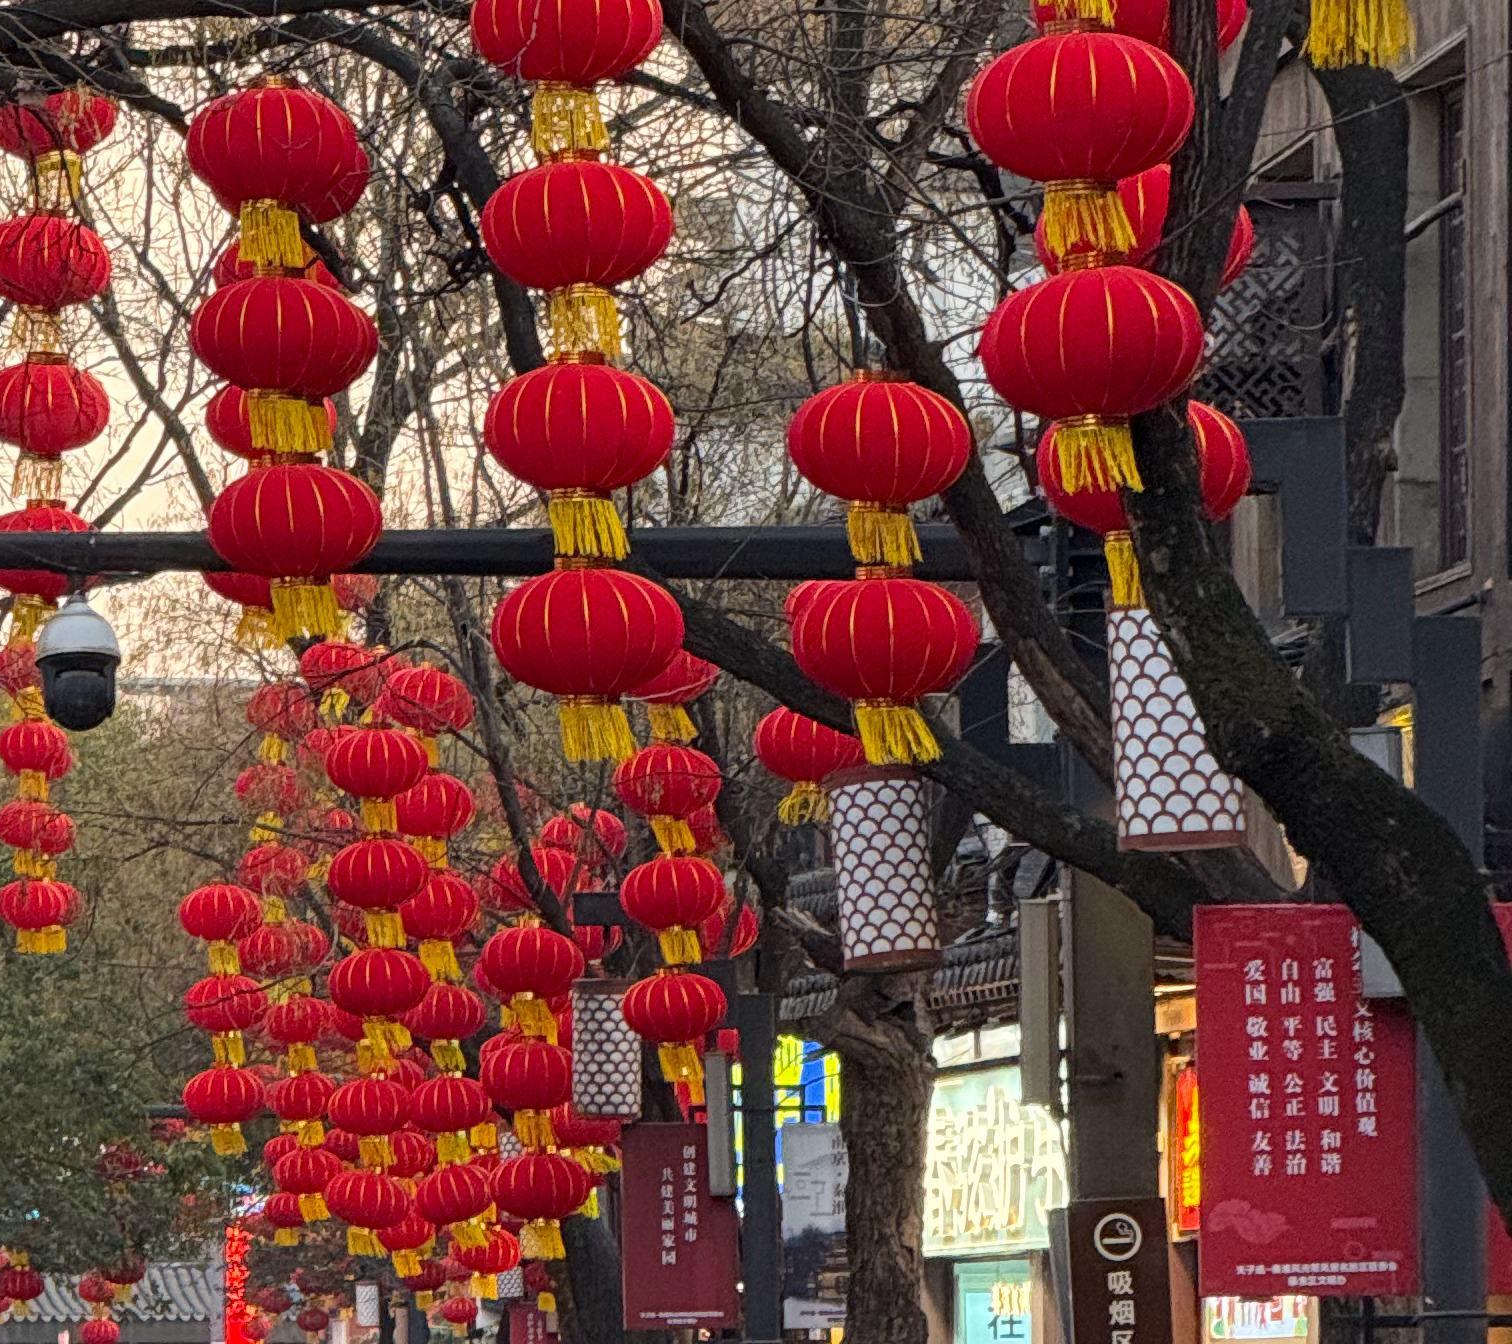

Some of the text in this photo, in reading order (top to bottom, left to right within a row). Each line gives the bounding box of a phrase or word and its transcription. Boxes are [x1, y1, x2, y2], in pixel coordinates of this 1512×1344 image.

[1244, 959, 1272, 1176] 爱国 敬业 诚信 友善
[1280, 959, 1307, 1175] 自由 平等 公正 法治
[1312, 957, 1342, 1175] 富强 民主 文明 和谐
[661, 1166, 676, 1265] 共建美丽家园
[682, 1145, 698, 1243] 创建文明城市
